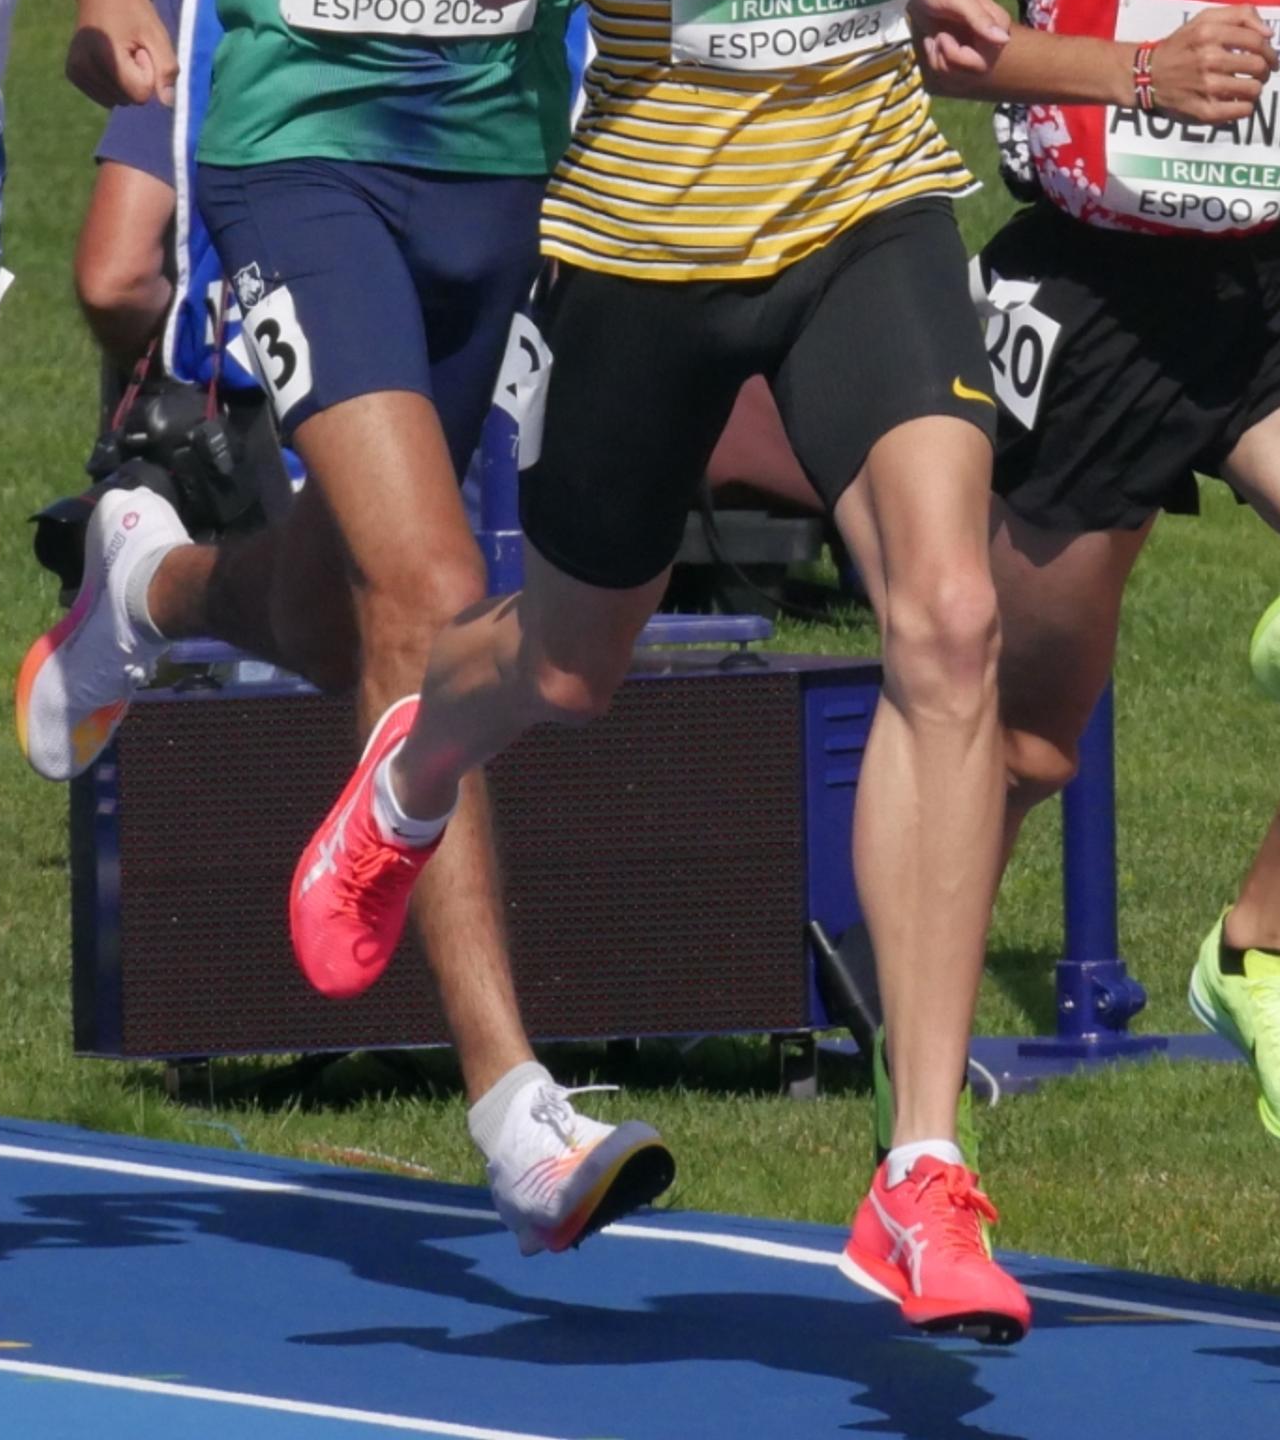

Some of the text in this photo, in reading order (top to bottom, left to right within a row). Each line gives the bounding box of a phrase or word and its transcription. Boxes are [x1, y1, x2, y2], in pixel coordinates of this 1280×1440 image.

[709, 13, 882, 60] ESPOO 2023
[1174, 162, 1225, 184] RUN
[1138, 190, 1254, 224] ESPOO
